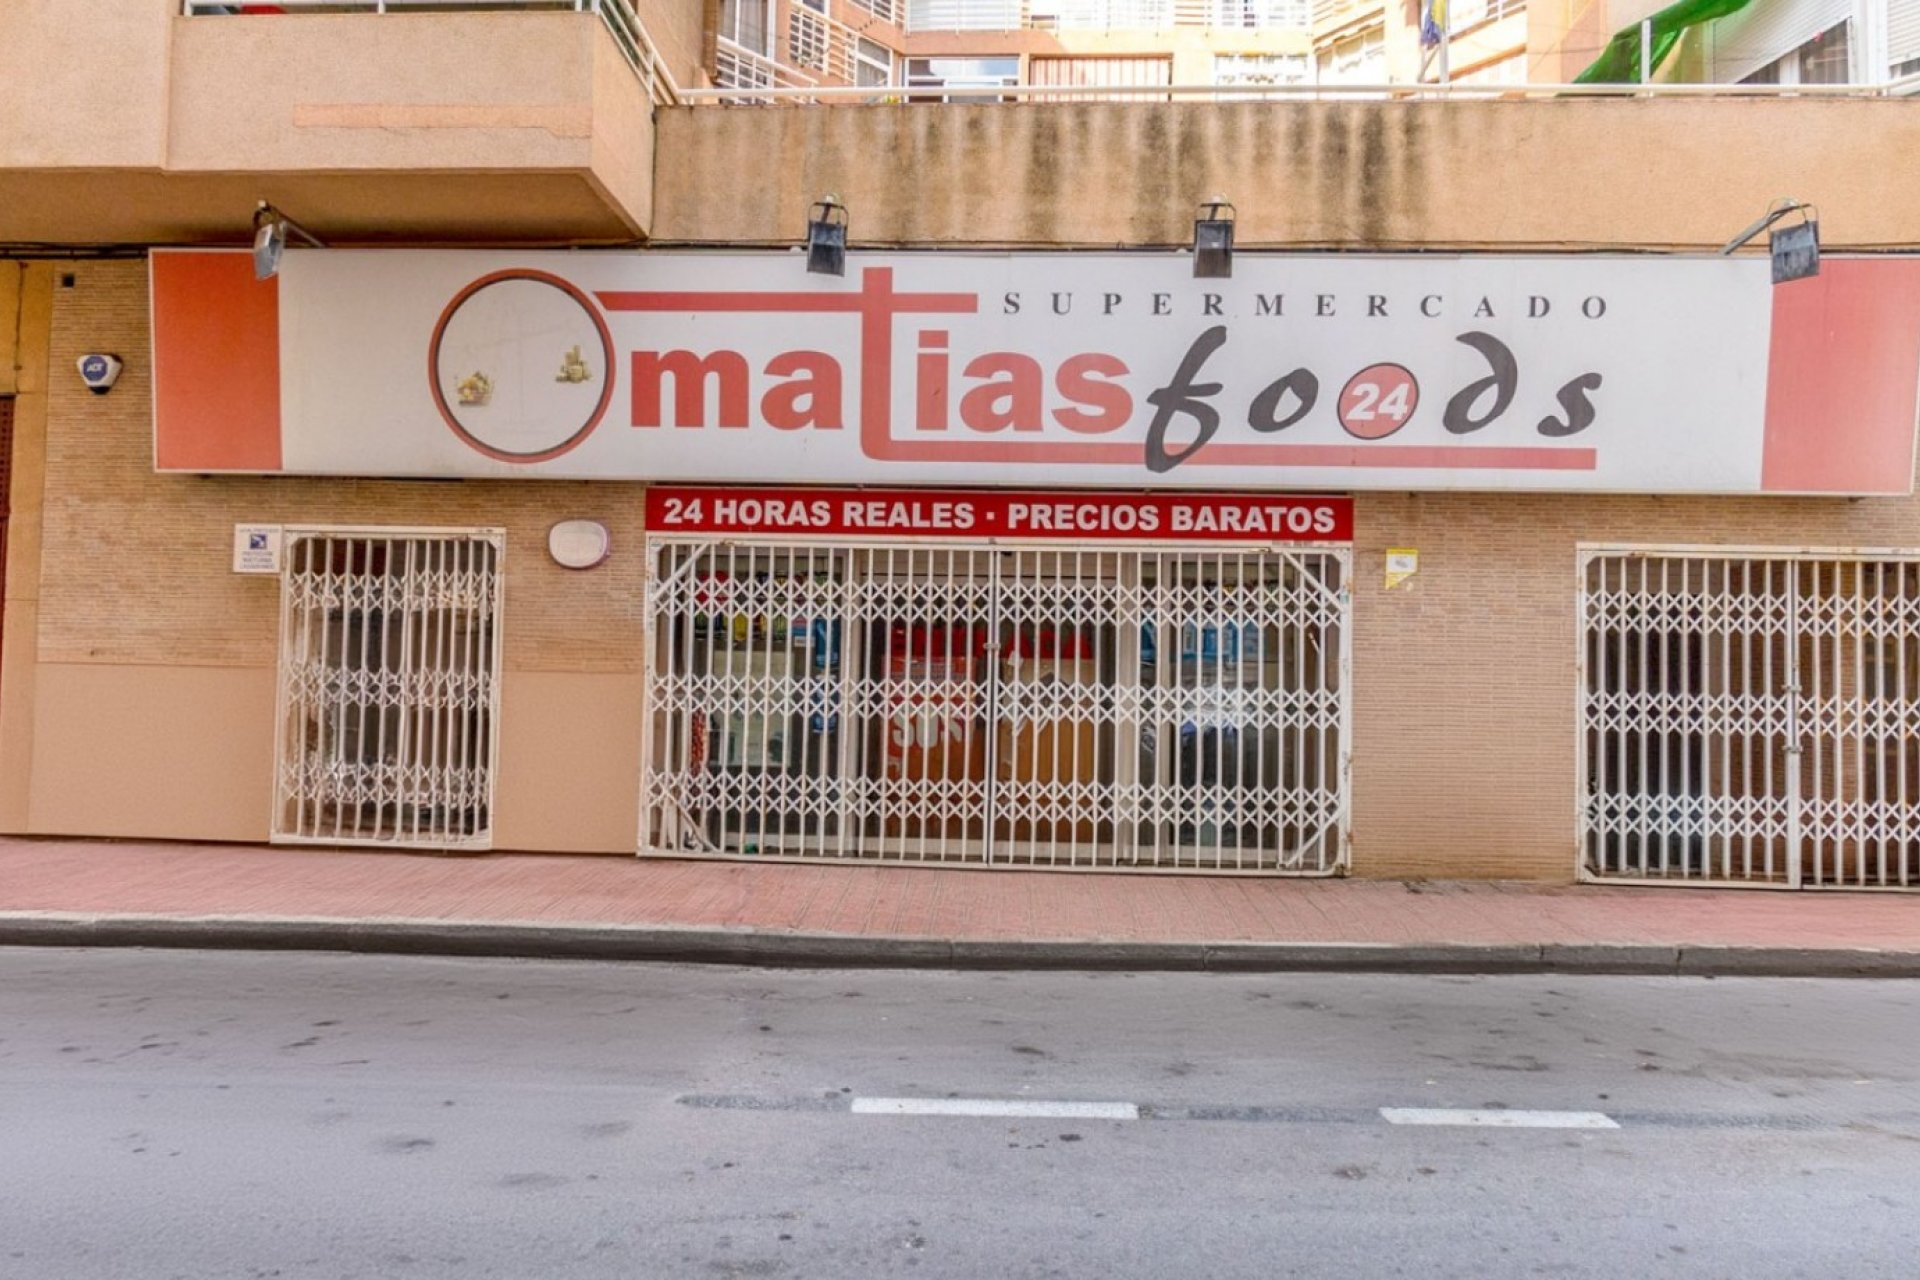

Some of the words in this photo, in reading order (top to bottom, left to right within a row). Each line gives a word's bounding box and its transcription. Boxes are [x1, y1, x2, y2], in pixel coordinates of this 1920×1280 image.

[1004, 292, 1607, 318] SUPERMERCADO
[631, 266, 1134, 463] matias
[1347, 383, 1410, 421] 24
[663, 498, 703, 524] 24
[714, 500, 831, 526] HORAS
[842, 502, 975, 529] REALES
[1008, 503, 1160, 531] PRECIOS
[1171, 505, 1335, 533] BARATOS
